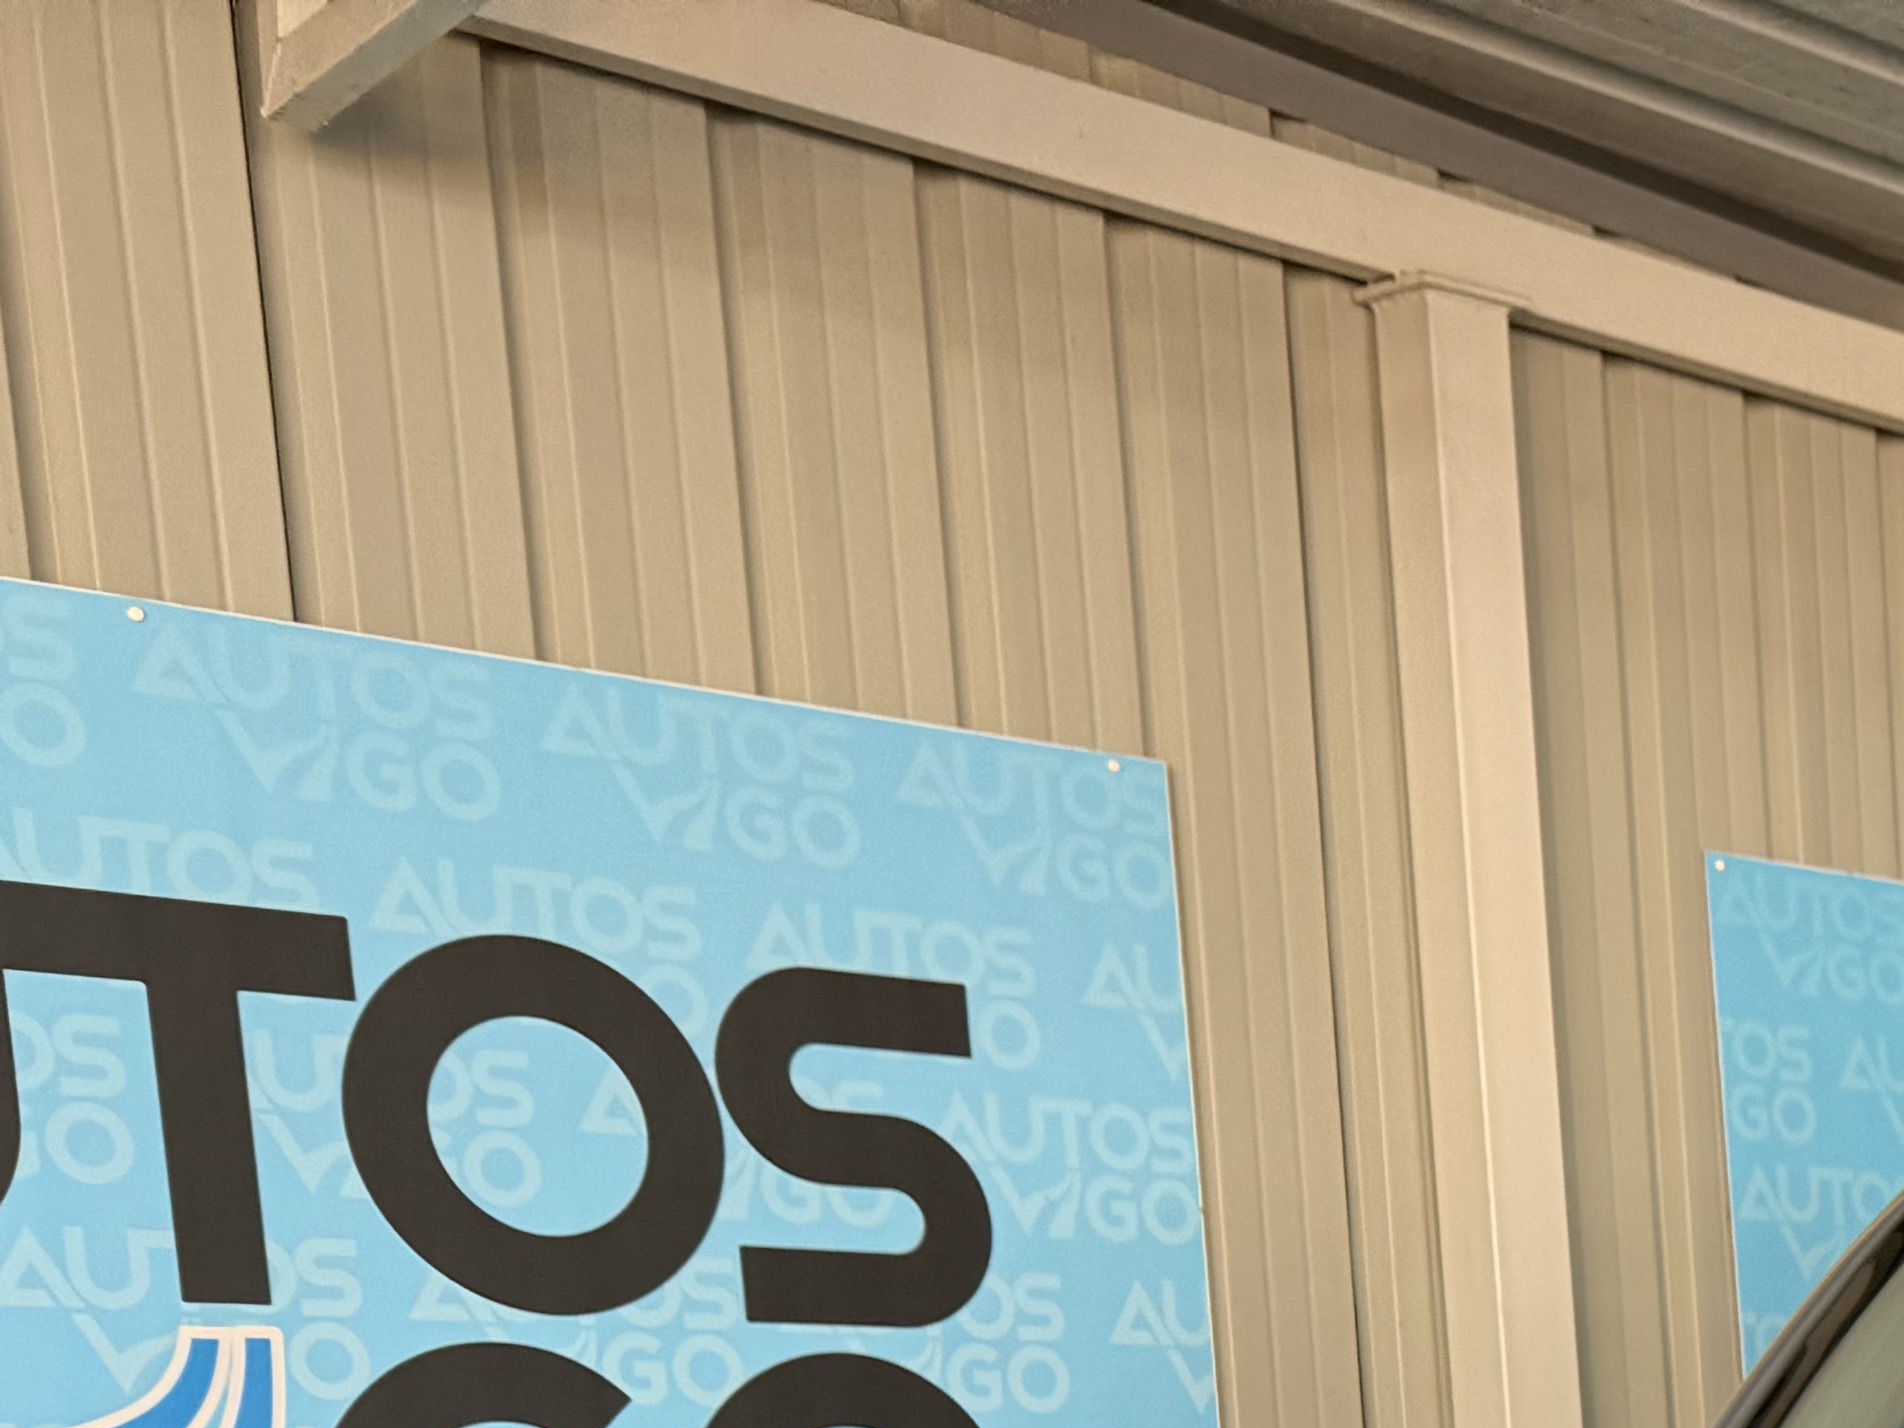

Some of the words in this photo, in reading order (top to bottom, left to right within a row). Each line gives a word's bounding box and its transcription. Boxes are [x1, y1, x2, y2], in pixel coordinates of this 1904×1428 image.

[130, 620, 494, 742] AUTOS
[215, 706, 502, 823] VIGO
[540, 680, 855, 793] AUTOS
[899, 738, 1165, 838] AUTOS
[606, 757, 862, 870] VIGO
[958, 812, 1171, 909] VIGO
[367, 853, 703, 963] AUTOS
[743, 899, 1035, 998] AUTOS
[936, 1090, 1195, 1173] AUTOS
[991, 1166, 1201, 1247] VIGO
